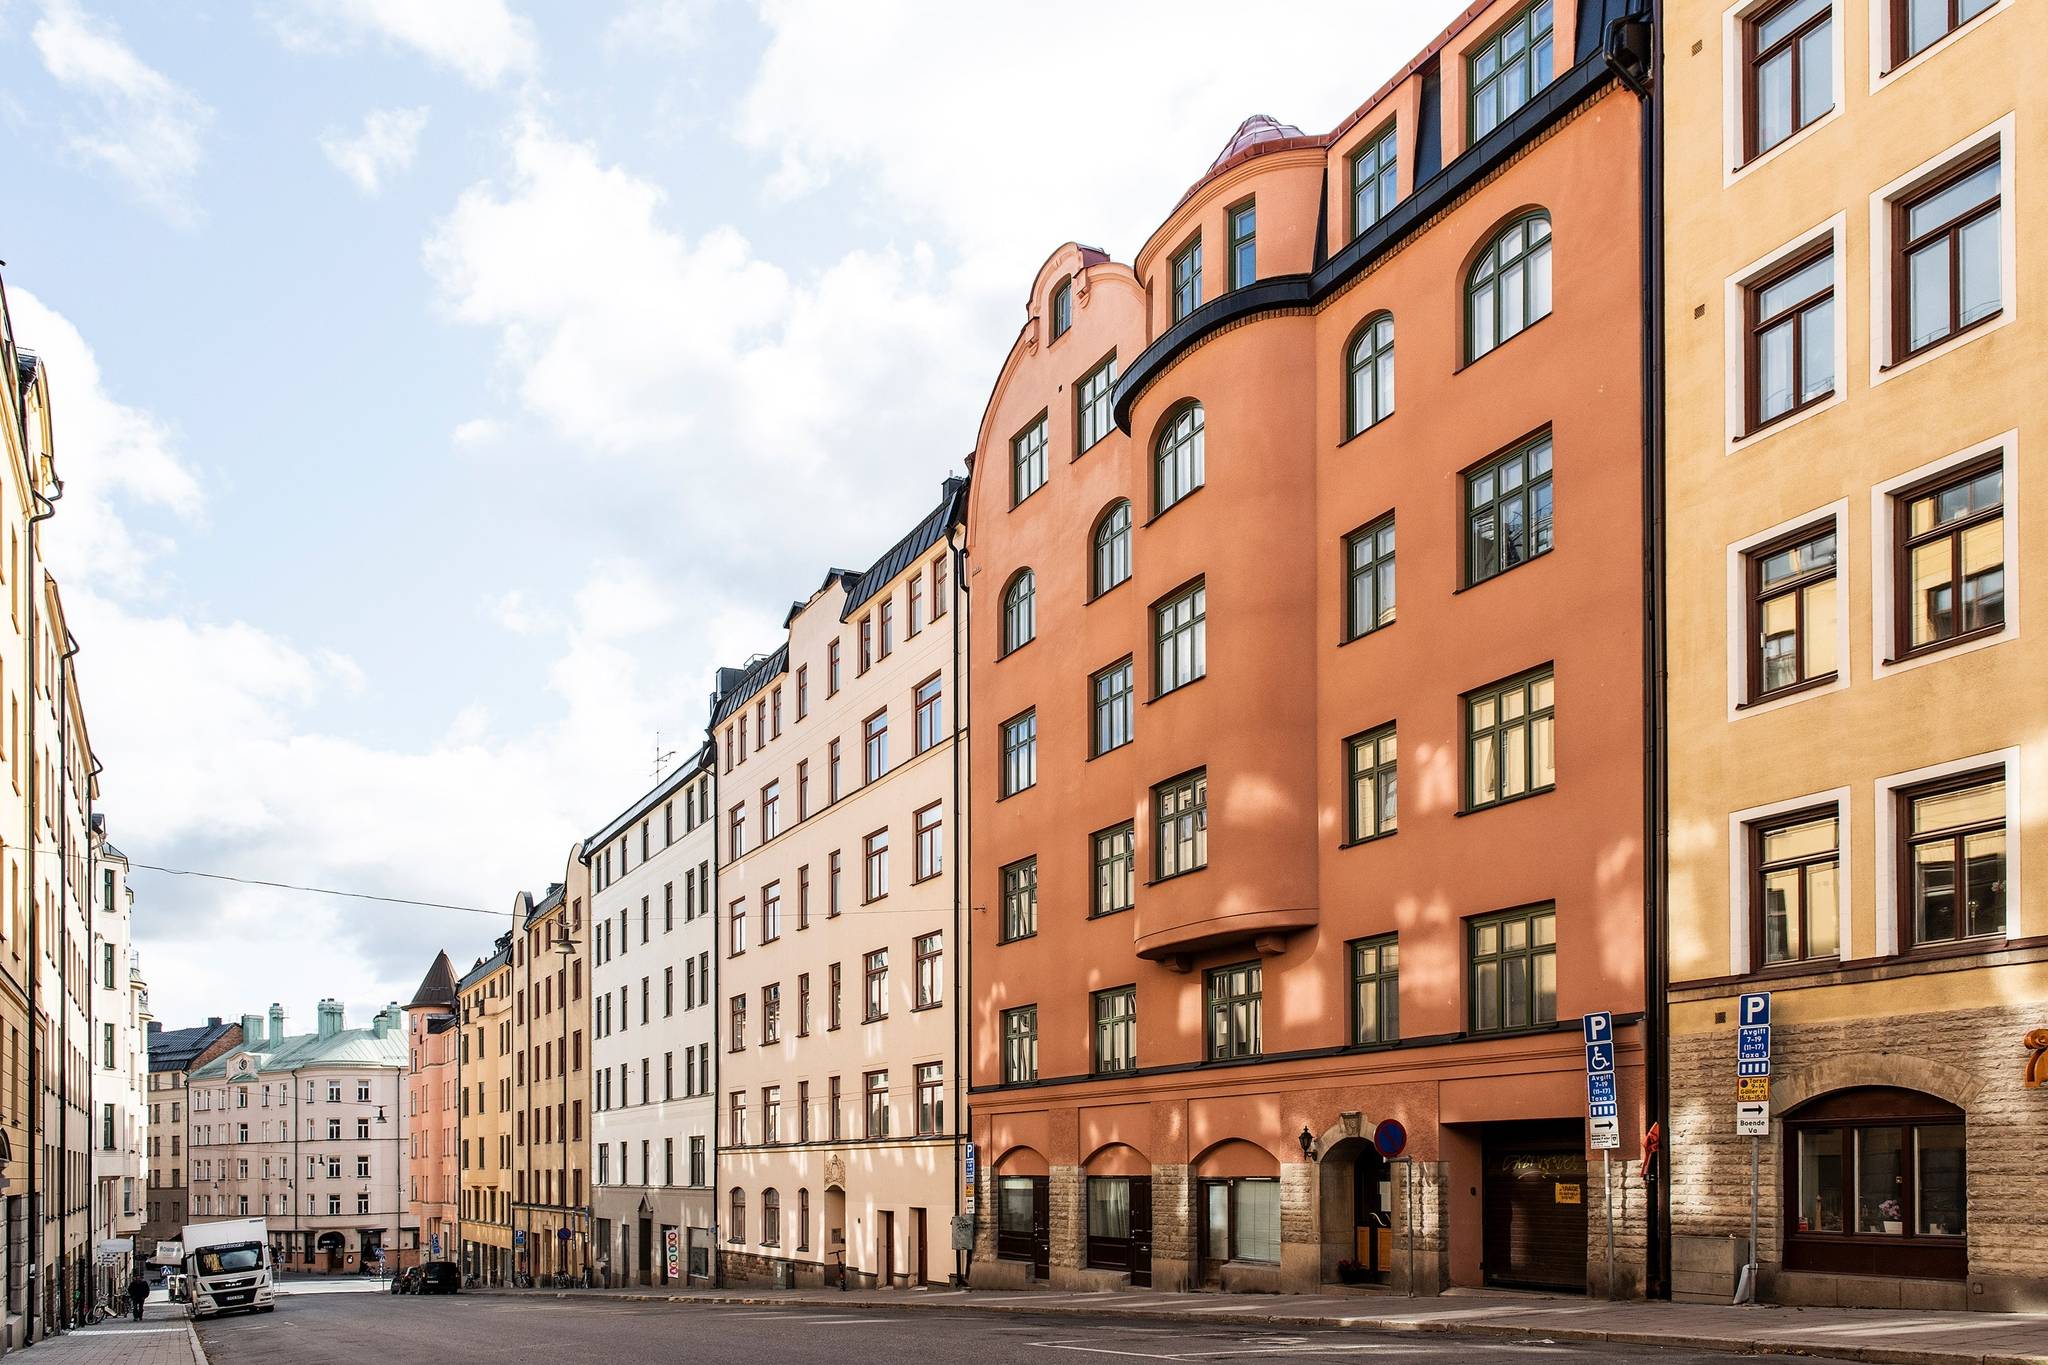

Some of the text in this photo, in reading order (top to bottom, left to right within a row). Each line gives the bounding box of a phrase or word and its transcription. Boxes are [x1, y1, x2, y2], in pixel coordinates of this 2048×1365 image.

[1746, 997, 1765, 1023] P
[1590, 1015, 1607, 1040] P
[1743, 1028, 1766, 1036] Avgift
[1743, 1043, 1765, 1051] (11-17)
[1591, 1074, 1612, 1082] Avgift
[967, 1144, 973, 1158] P
[517, 1230, 523, 1238] P
